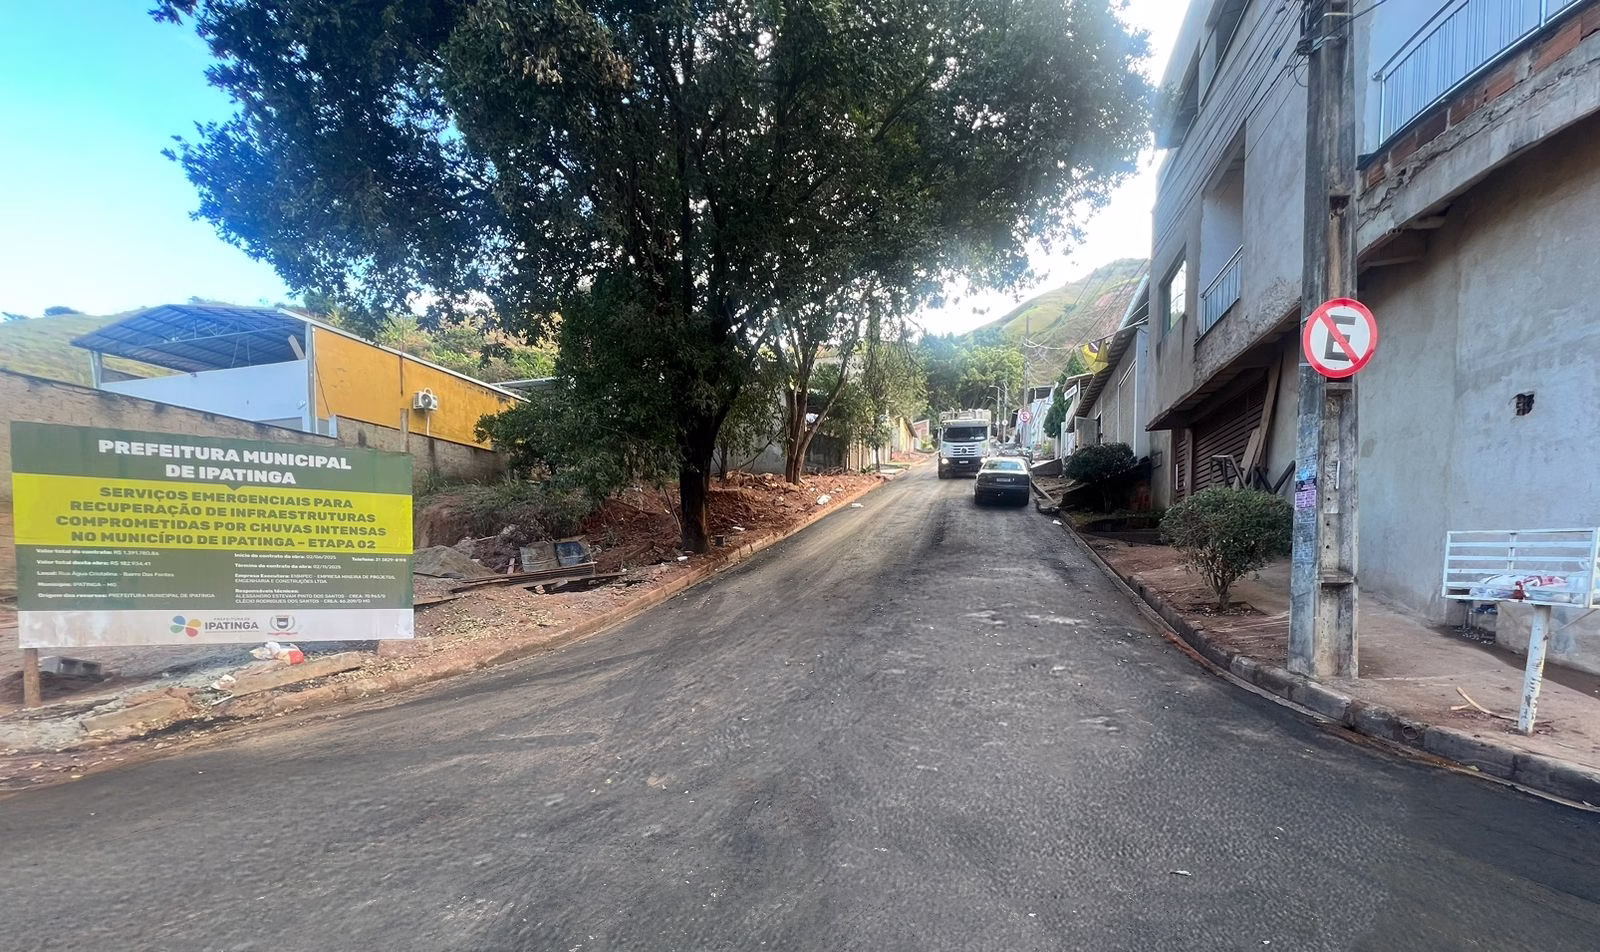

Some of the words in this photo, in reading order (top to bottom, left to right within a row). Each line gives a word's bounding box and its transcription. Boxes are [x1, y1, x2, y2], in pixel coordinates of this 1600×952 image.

[1325, 314, 1355, 361] E
[98, 440, 240, 461] PREFEITURA
[243, 451, 351, 470] MUNICIPAL
[166, 465, 195, 479] DE
[199, 468, 296, 485] IPATINGA
[100, 487, 187, 502] SERVIÇOS
[192, 491, 309, 507] EMERGENCIAIS
[314, 496, 353, 508] PARA
[70, 499, 201, 517] RECUPERAÇÃO
[206, 506, 226, 516] DE
[230, 507, 376, 522] INFRAESTRUTURAS
[56, 515, 210, 530] COMPROMETIDAS
[214, 521, 246, 532] POR
[249, 522, 311, 535] CHUVAS
[315, 525, 386, 536] INTENSAS
[72, 532, 97, 542] NO
[101, 530, 192, 544] MUNICÍPIO
[198, 534, 218, 545] DE
[222, 535, 294, 546] IPATINGA
[308, 538, 355, 548] ETAPA
[357, 540, 375, 548] 02
[205, 622, 258, 630] IPATINGA
